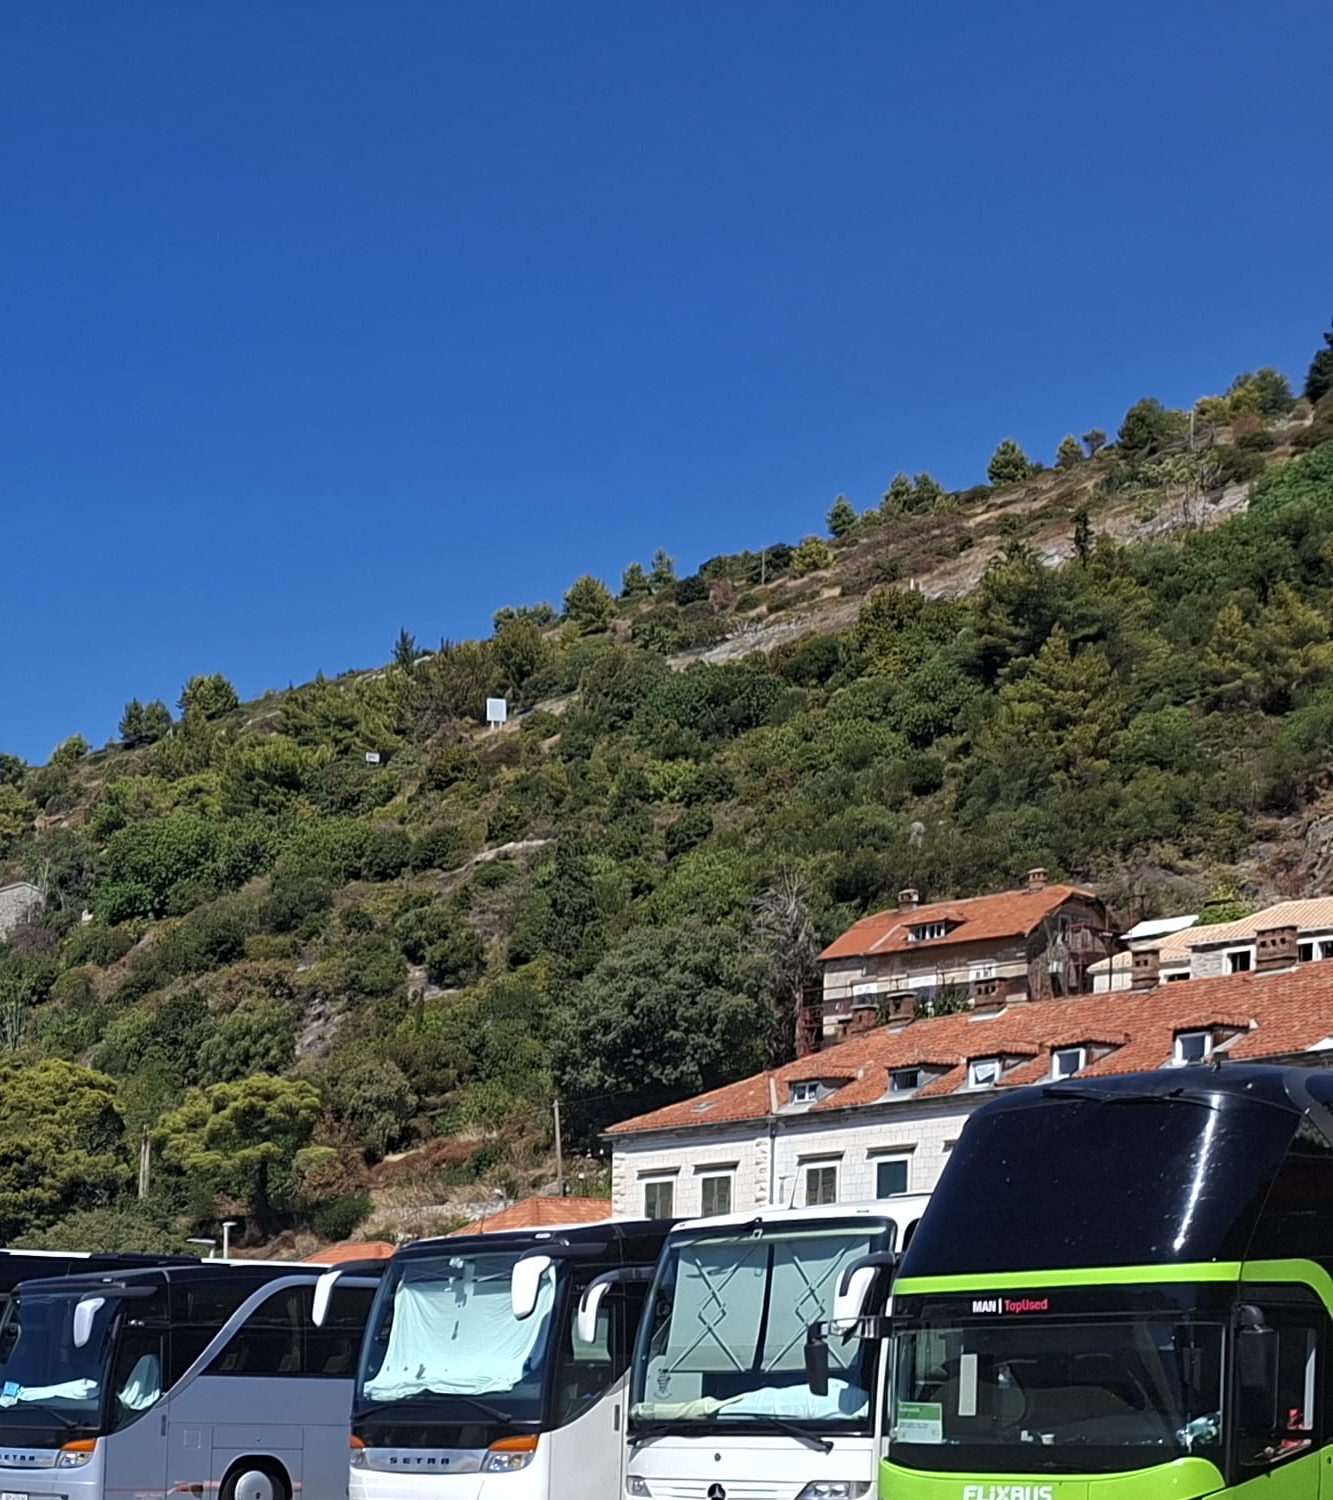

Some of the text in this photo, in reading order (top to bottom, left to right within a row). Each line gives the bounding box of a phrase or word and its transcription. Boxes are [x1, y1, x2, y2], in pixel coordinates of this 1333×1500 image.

[972, 1298, 1048, 1313] MAN TopUsed
[389, 1456, 450, 1465] SETRA
